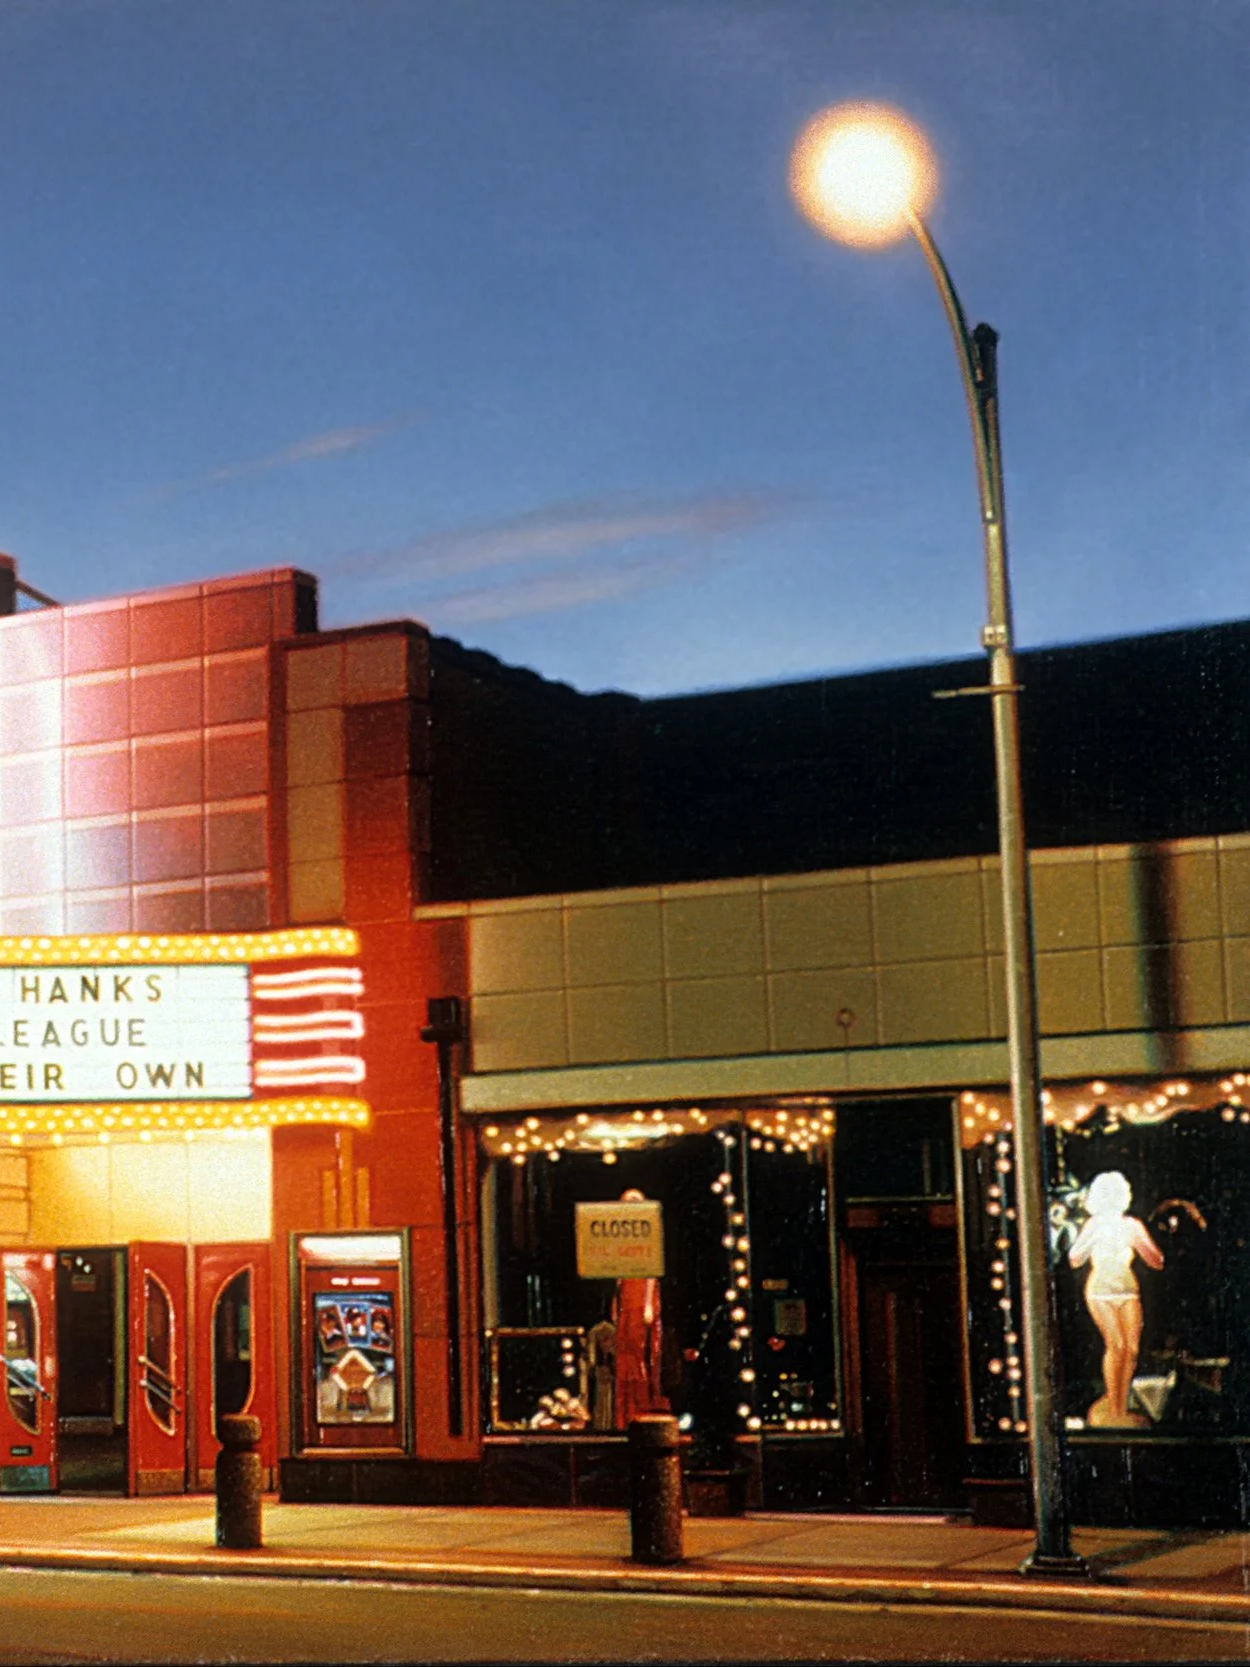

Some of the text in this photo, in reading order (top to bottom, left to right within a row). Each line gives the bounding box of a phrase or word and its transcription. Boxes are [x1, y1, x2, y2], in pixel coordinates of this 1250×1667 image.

[21, 974, 162, 1003] HANKS
[116, 1061, 204, 1089] OWN
[589, 1219, 652, 1238] CLOSED
